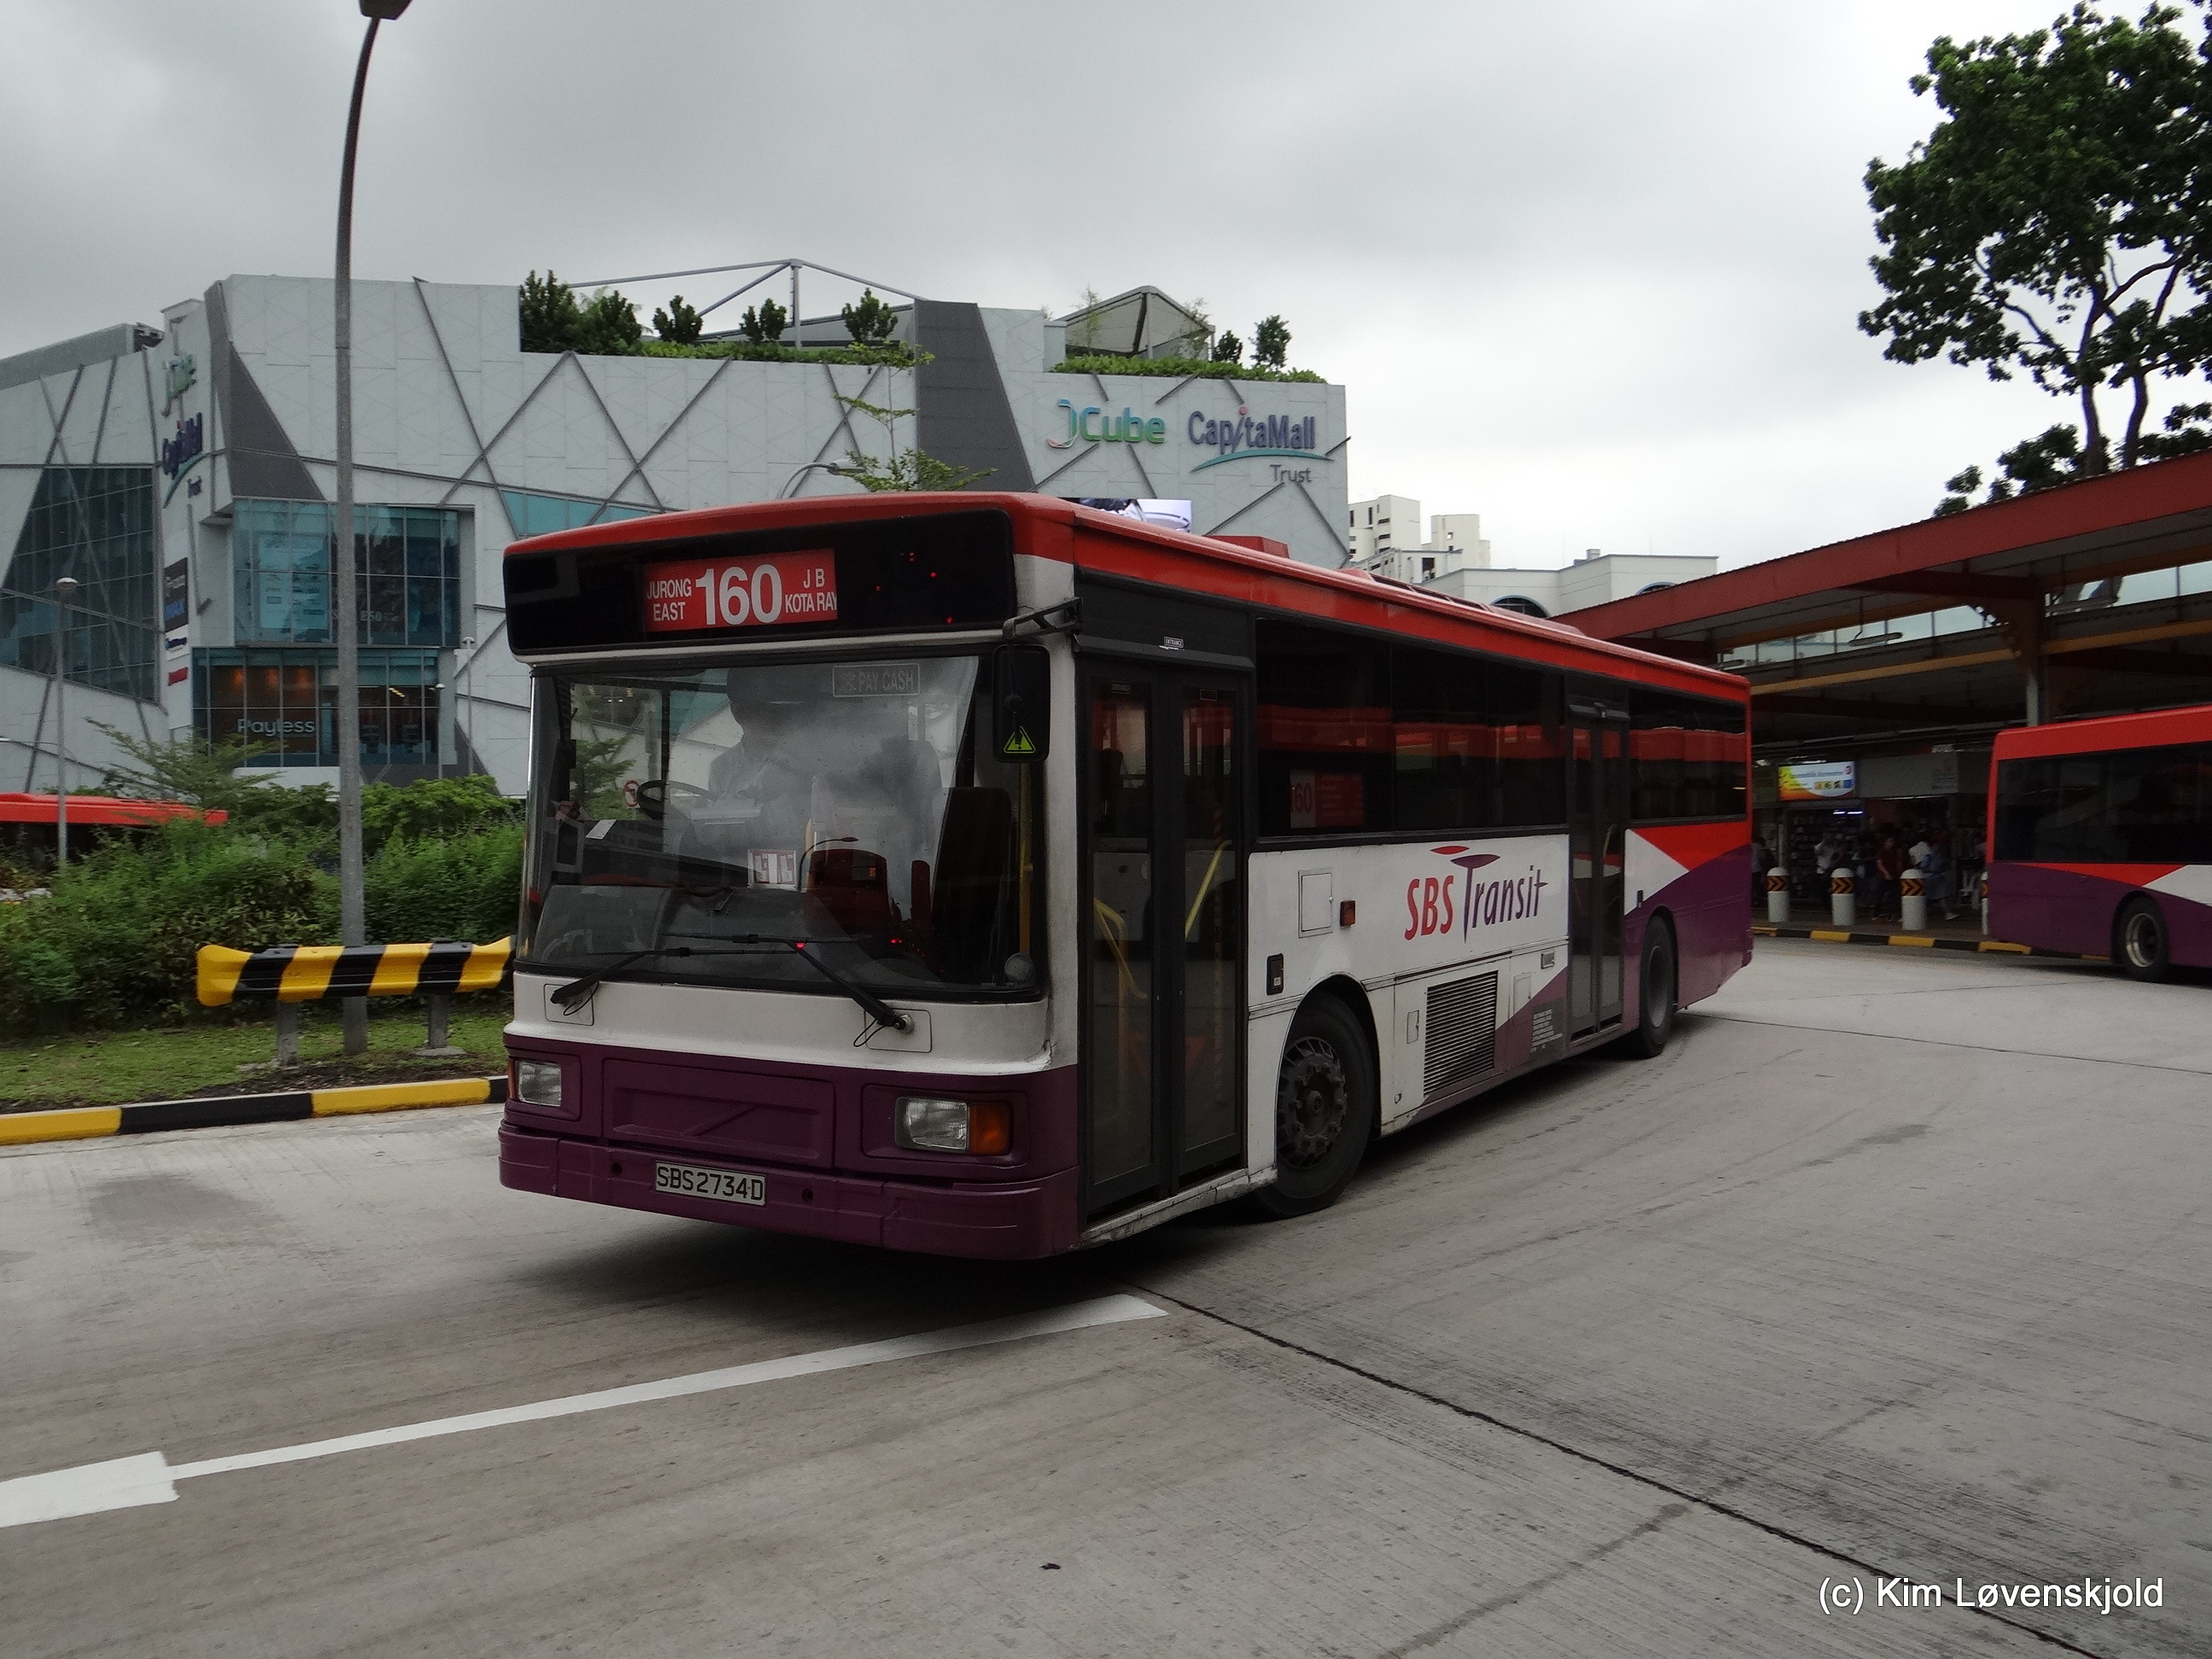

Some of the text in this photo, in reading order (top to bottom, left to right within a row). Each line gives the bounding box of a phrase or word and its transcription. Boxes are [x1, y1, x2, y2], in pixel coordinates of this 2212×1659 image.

[1187, 405, 1316, 455] CapitaMall
[1269, 463, 1313, 483] Trust
[646, 578, 692, 600] JURONG
[695, 564, 782, 626] 160
[653, 601, 686, 622] EAST
[785, 593, 815, 614] KOTA
[882, 669, 914, 692] CASH
[237, 719, 316, 736] Payless
[1404, 854, 1549, 944] SBS Transit
[656, 1166, 764, 1201] SBS2734D
